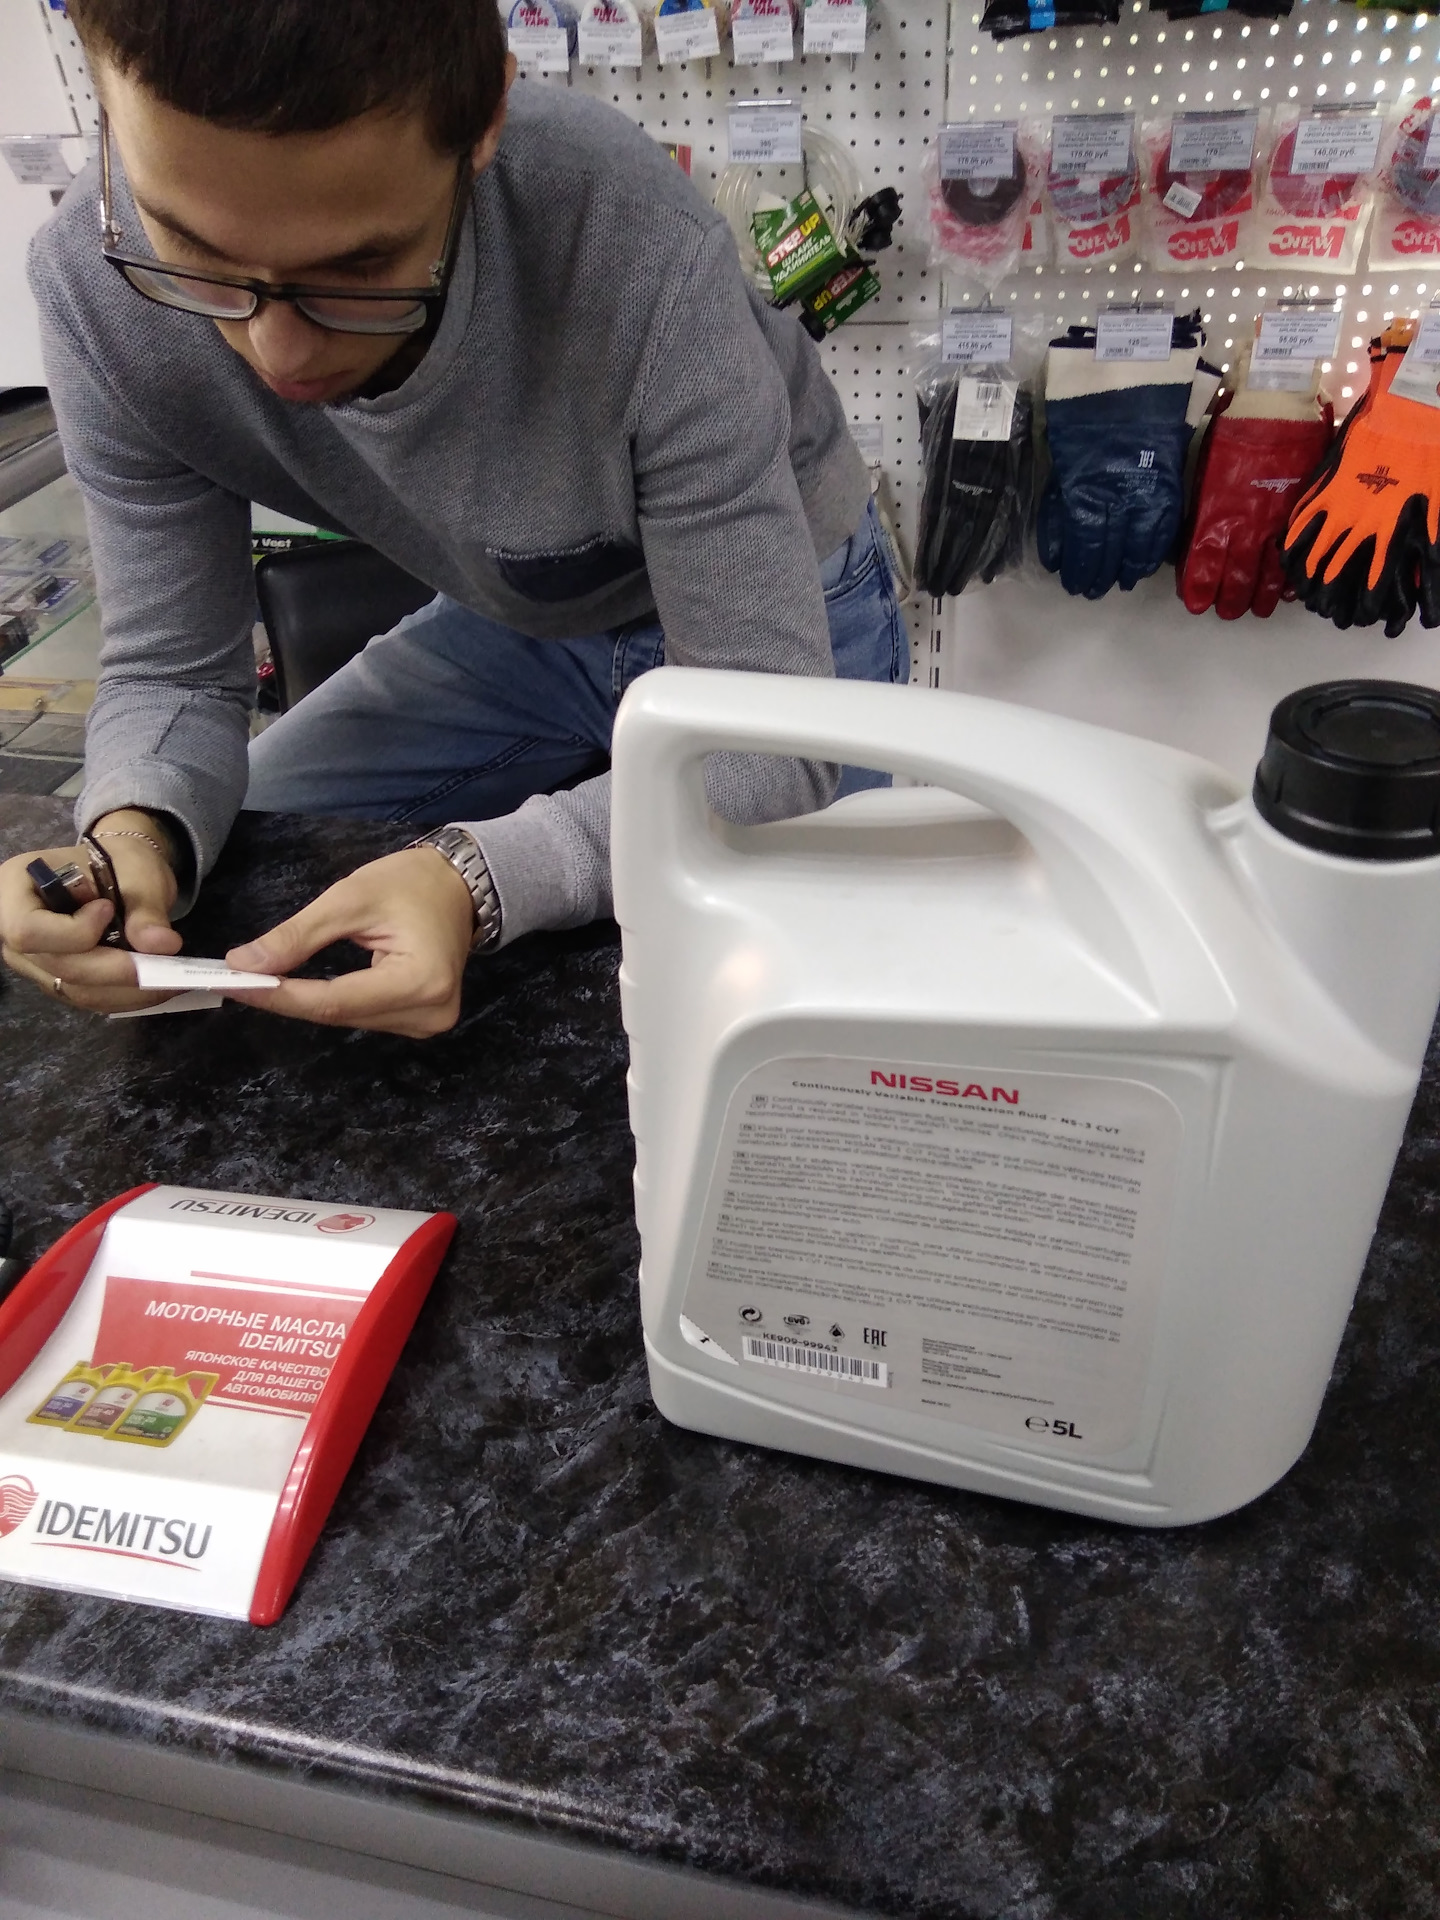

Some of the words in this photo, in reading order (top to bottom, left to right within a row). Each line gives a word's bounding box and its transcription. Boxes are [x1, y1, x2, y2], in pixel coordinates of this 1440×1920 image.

[767, 229, 802, 267] STEP
[800, 212, 820, 237] UP
[1138, 449, 1156, 469] EAC
[870, 1069, 1019, 1105] NISSAN
[792, 1080, 872, 1096] Continuously
[875, 1090, 926, 1103] Variable
[930, 1098, 1014, 1116] Transmission
[1060, 1117, 1092, 1130] NS-3
[1095, 1124, 1121, 1135] CVT
[169, 1199, 317, 1225] IDEMITSU
[145, 1301, 267, 1330] МОТОРНЫЕ
[270, 1314, 347, 1339] МАСЛА
[239, 1333, 342, 1360] IDEMITSU
[762, 1332, 838, 1353] KE909-99943
[863, 1327, 888, 1347] EAC
[184, 1350, 259, 1369] ЯПОНСКОЕ
[260, 1360, 330, 1378] КАЧЕСТВО
[222, 1382, 317, 1404] АВТОМОБИЛЯ
[232, 1370, 262, 1384] ДЛЯ
[265, 1374, 324, 1391] ВАШЕГО
[1052, 1419, 1082, 1439] 5L
[36, 1500, 213, 1560] IDEMITSU
